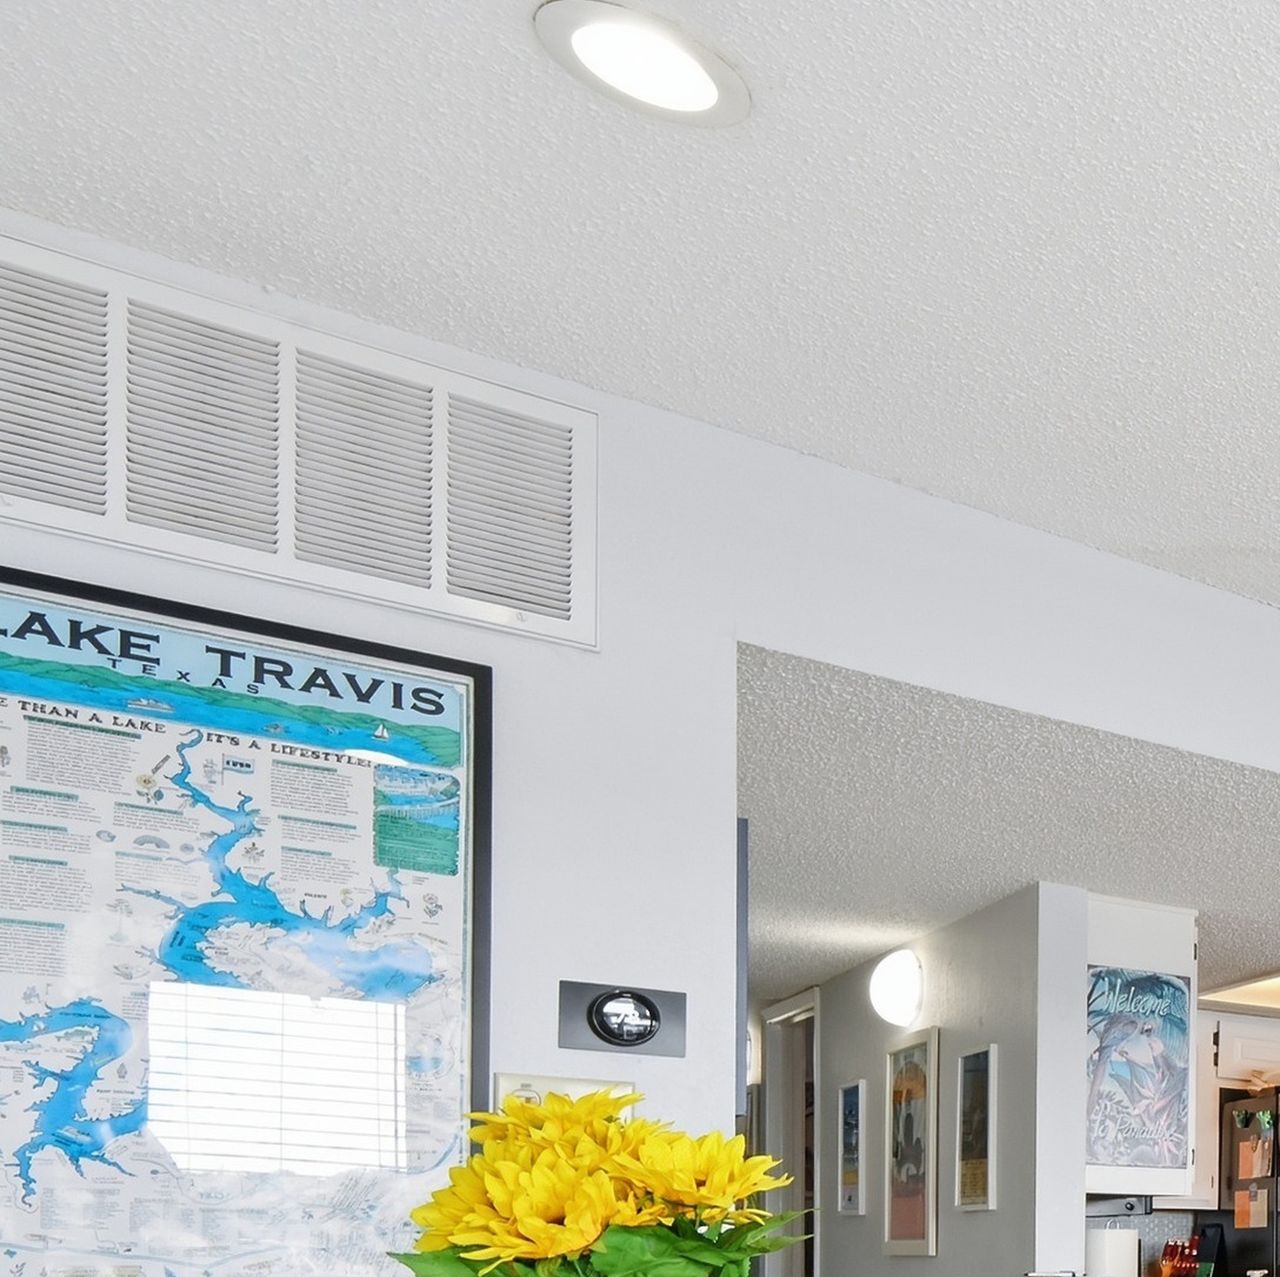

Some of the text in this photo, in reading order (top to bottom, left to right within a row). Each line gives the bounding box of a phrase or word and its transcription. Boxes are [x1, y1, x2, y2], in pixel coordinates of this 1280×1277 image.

[0, 611, 446, 716] AKE TRAVIS
[107, 657, 260, 695] TEXAS
[18, 700, 79, 720] THAN
[88, 712, 103, 724] A
[112, 715, 167, 734] LAKE
[206, 732, 241, 747] IT'S
[248, 739, 262, 750] A
[270, 743, 373, 769] LIFESTYLE!
[1102, 977, 1172, 1018] Welcome
